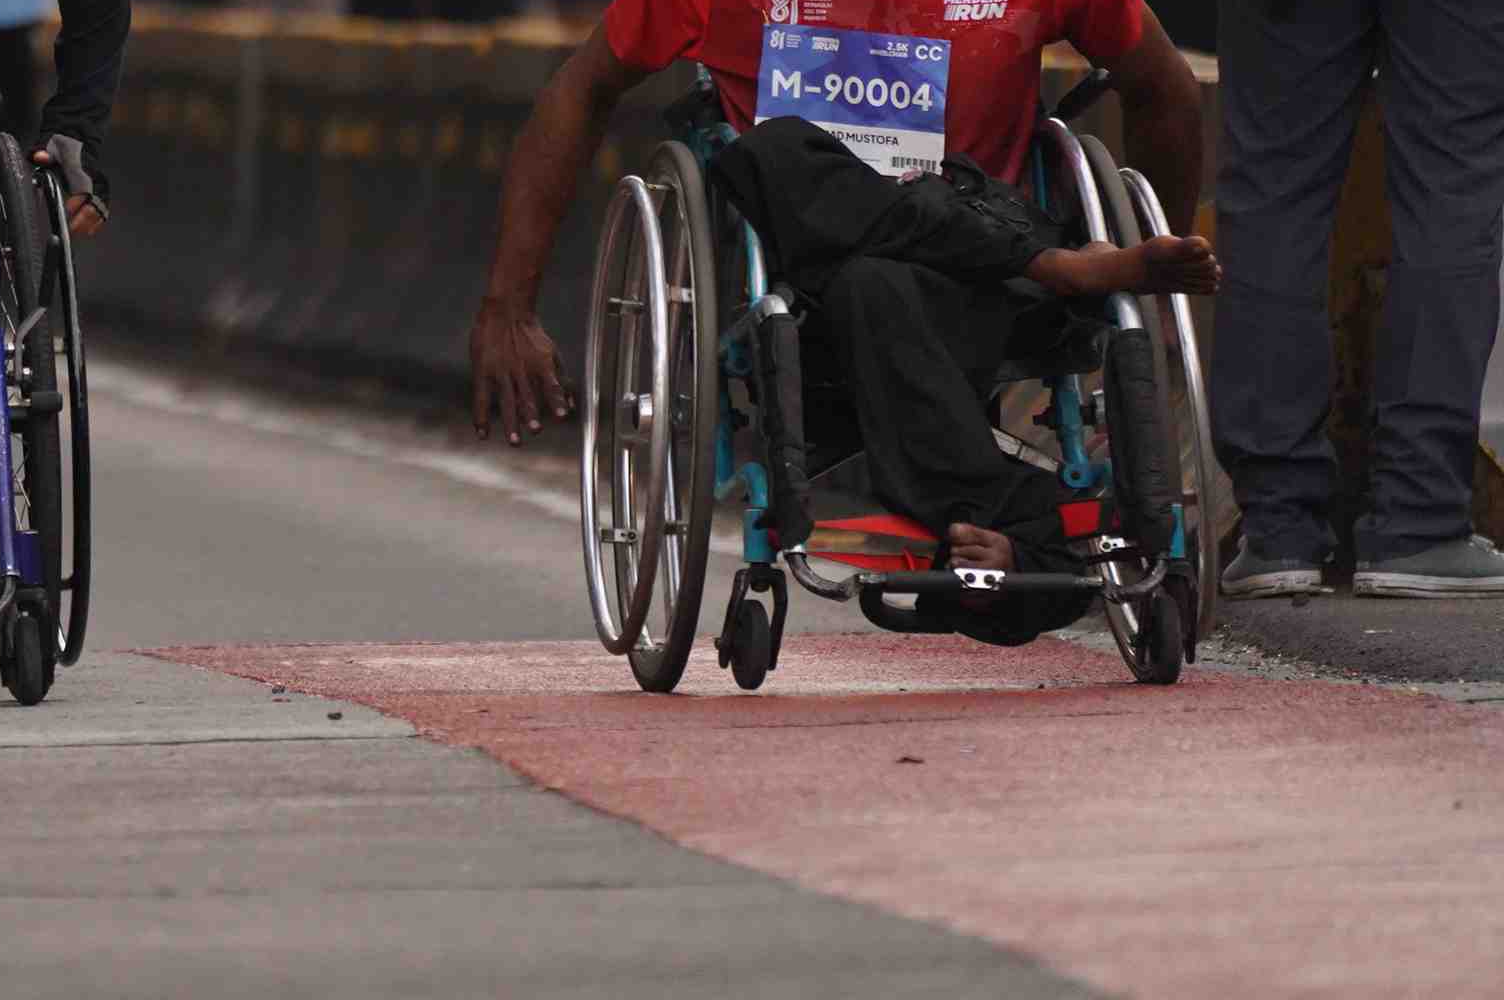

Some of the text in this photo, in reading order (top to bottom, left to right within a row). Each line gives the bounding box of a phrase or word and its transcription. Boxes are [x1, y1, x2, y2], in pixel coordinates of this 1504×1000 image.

[952, 2, 1008, 21] RUN
[769, 29, 786, 50] 81
[915, 44, 944, 61] CC
[771, 68, 934, 113] M-90004
[845, 131, 900, 146] MUSTOFA
